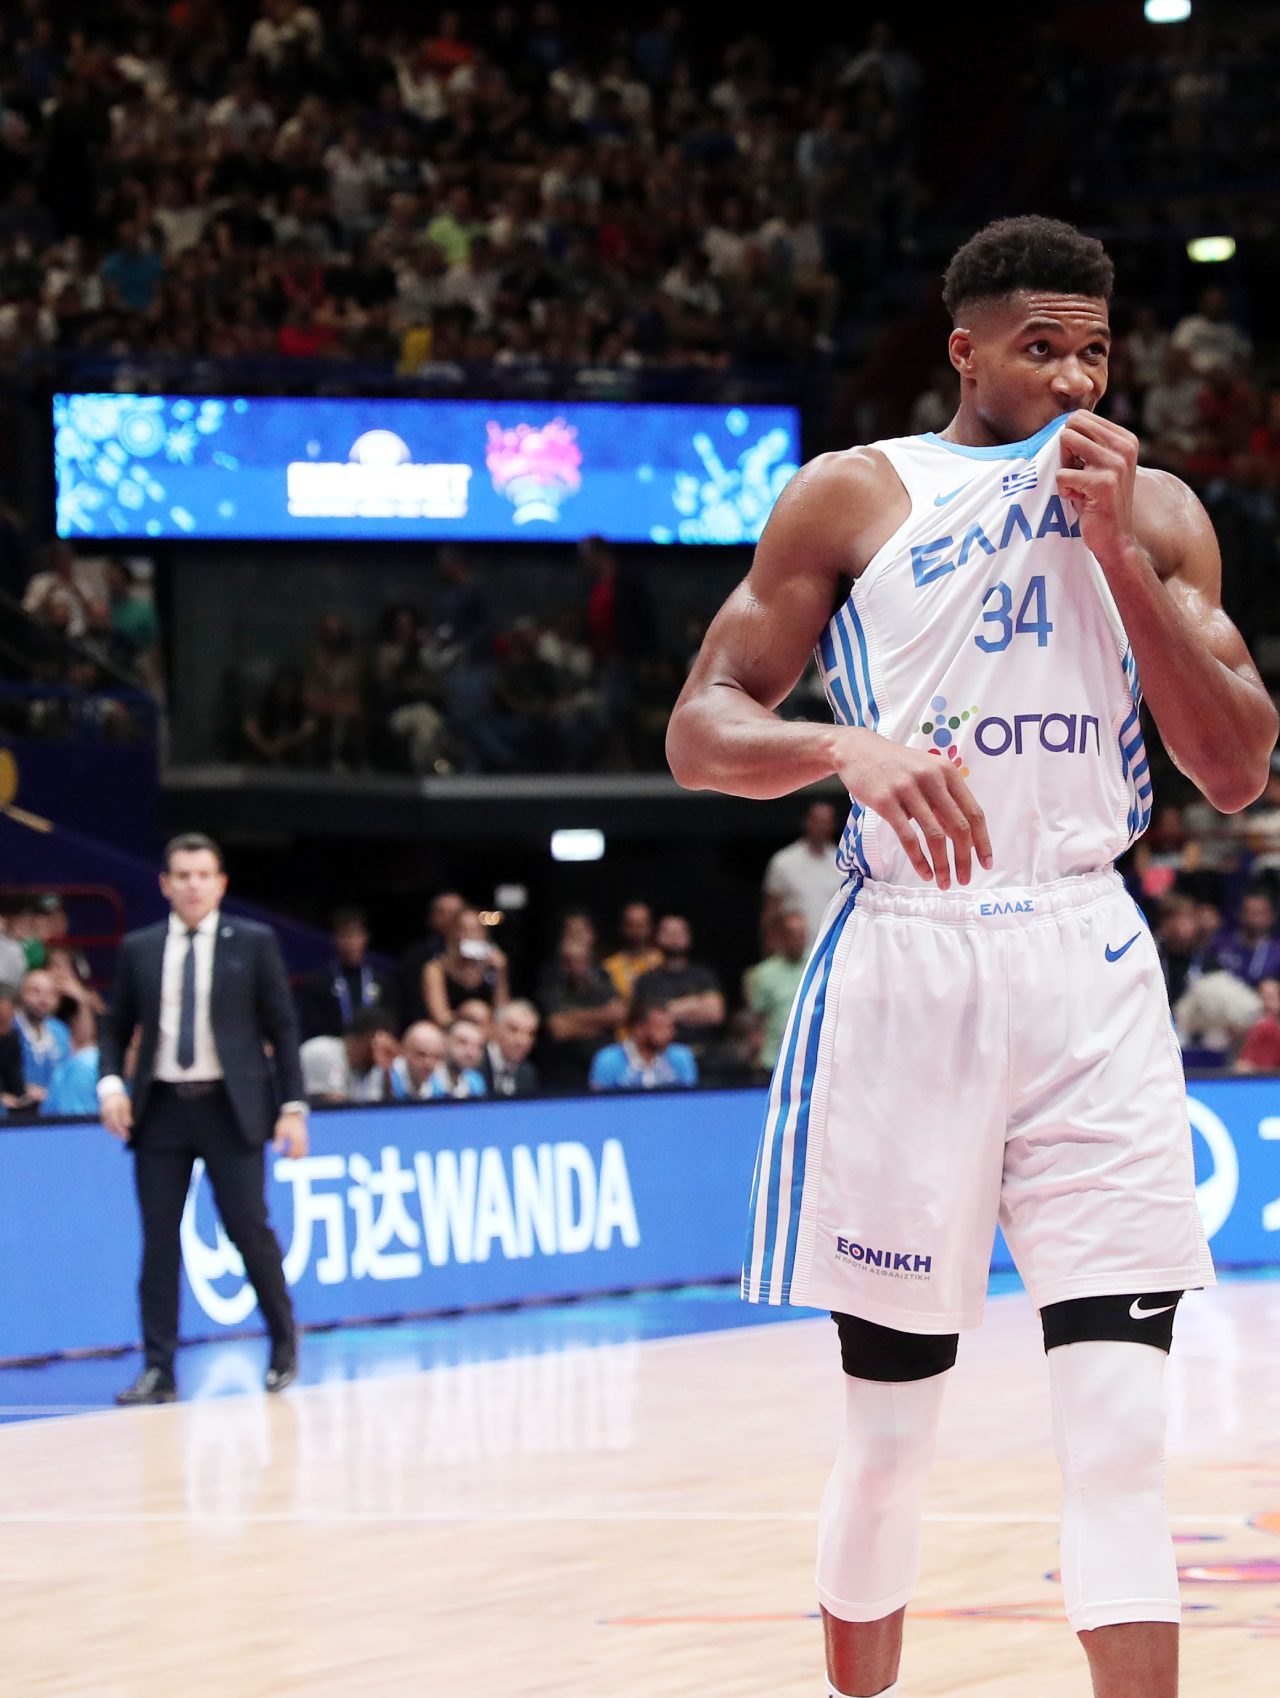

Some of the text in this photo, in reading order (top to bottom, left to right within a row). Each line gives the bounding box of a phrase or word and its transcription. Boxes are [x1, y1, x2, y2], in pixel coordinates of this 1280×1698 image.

[974, 575, 1053, 653] 34
[980, 900, 1034, 916] ΕΛΛΑΣ
[414, 1138, 641, 1267] WANDA
